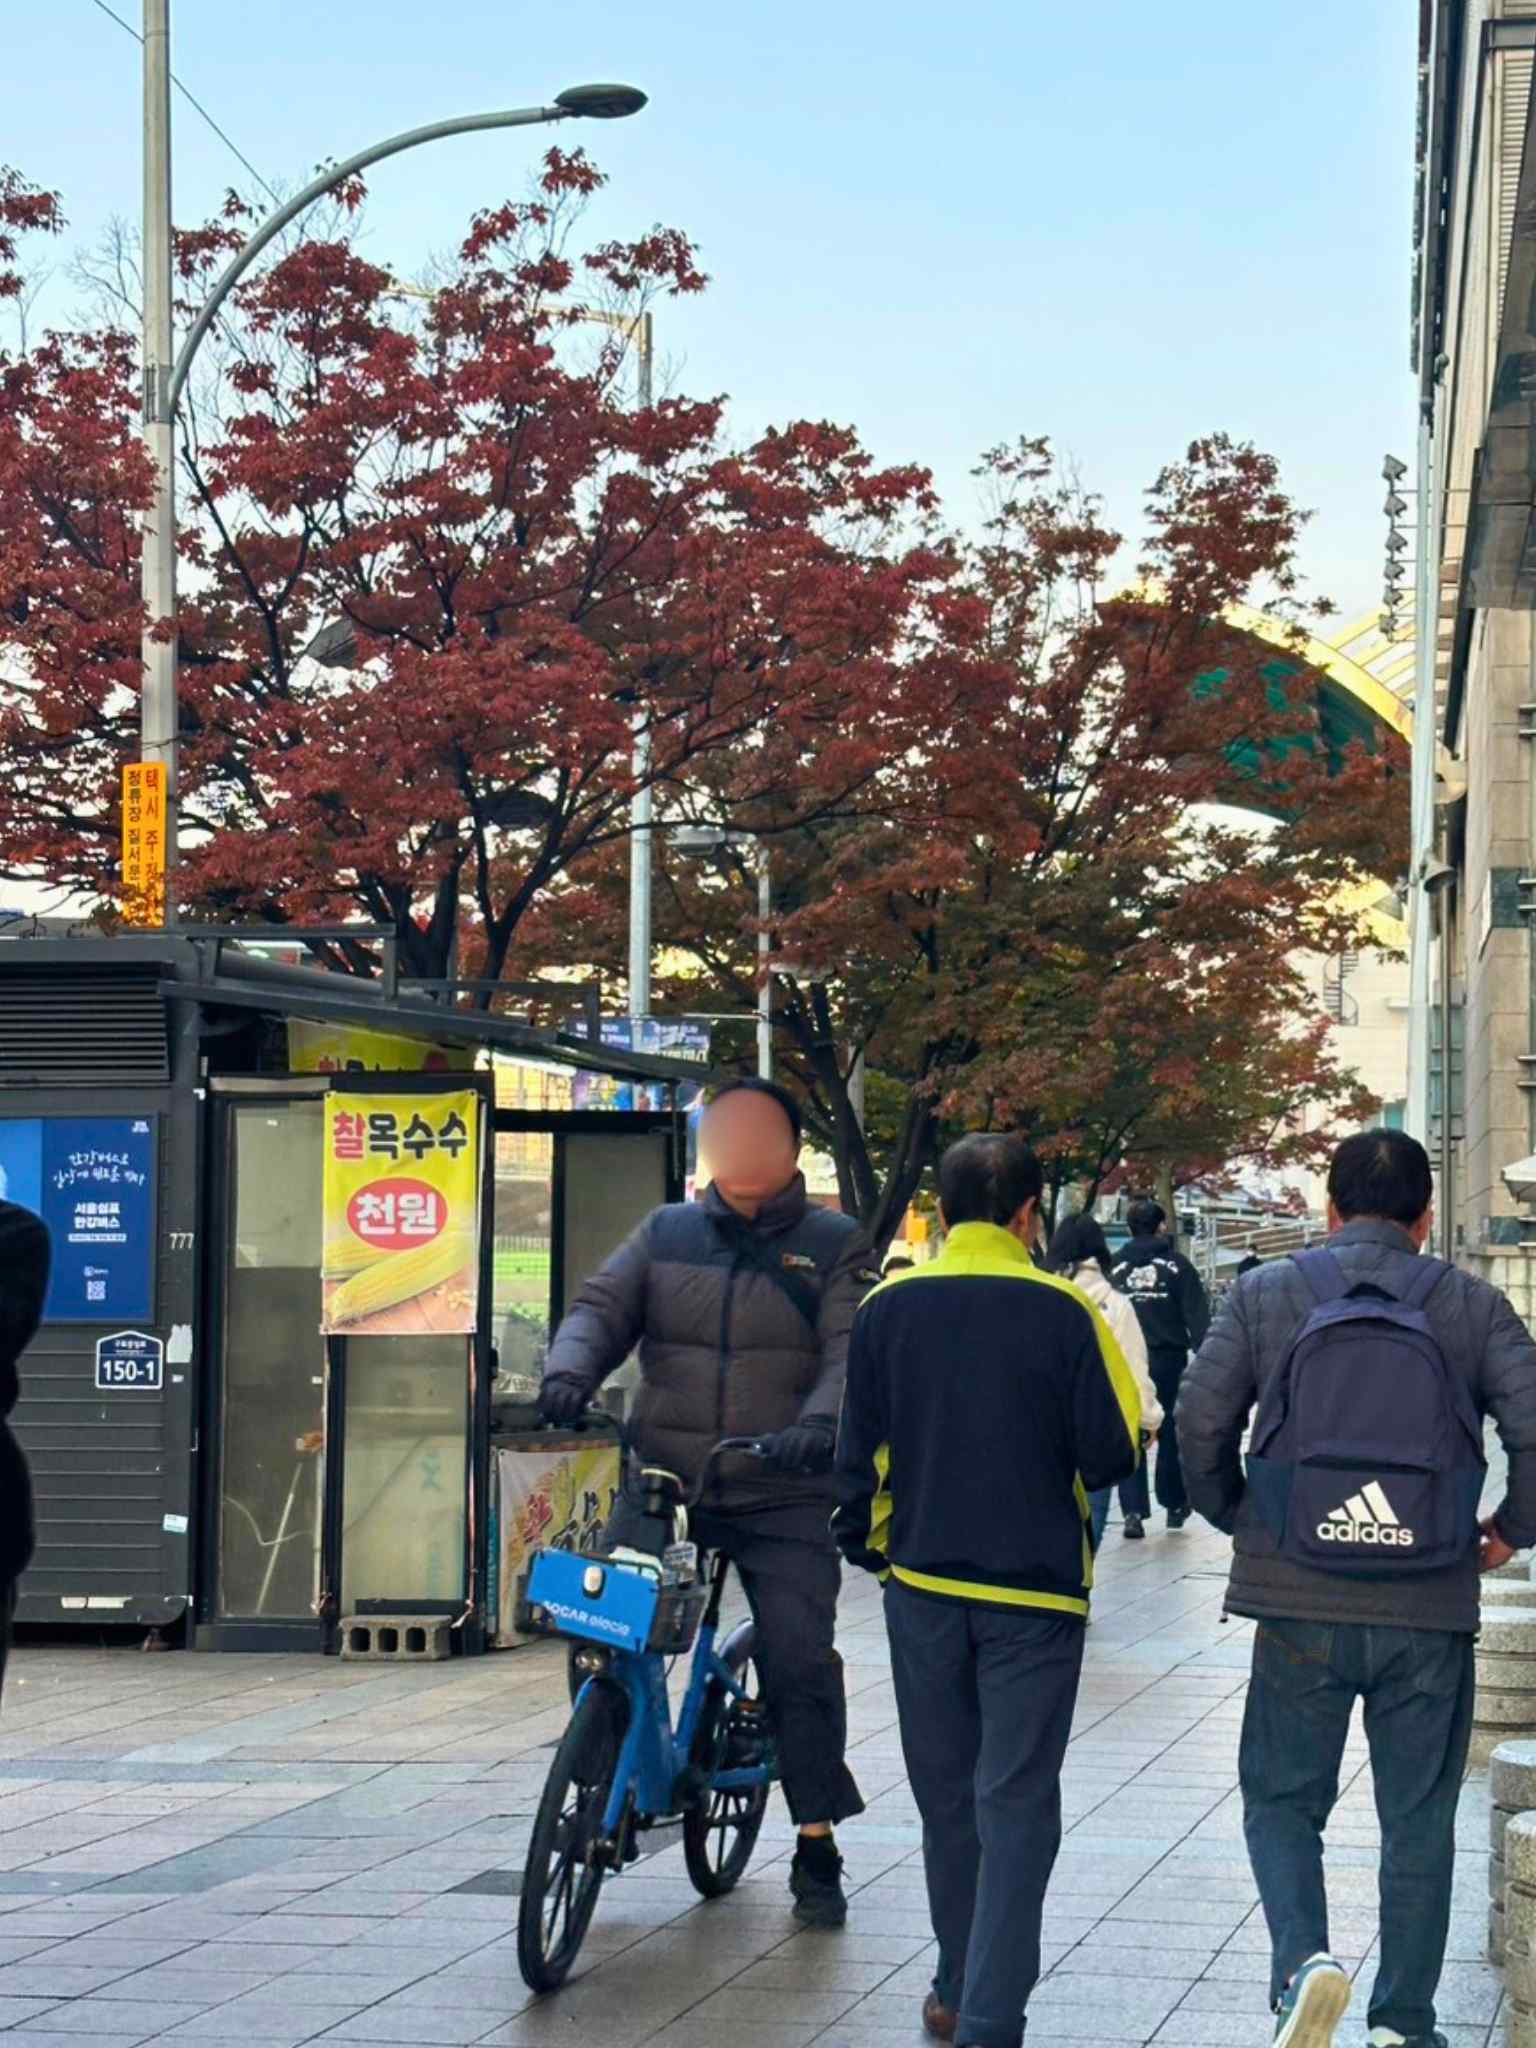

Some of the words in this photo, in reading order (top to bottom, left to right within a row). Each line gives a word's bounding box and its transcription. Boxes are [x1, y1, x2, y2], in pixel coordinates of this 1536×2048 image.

[127, 770, 141, 823] 정류장
[145, 769, 159, 820] 택시
[333, 1111, 468, 1161] 찰옥수수
[355, 1191, 438, 1236] 천원
[169, 1233, 194, 1250] 777
[103, 1360, 155, 1382] 150-1
[1316, 1520, 1415, 1546] adidas
